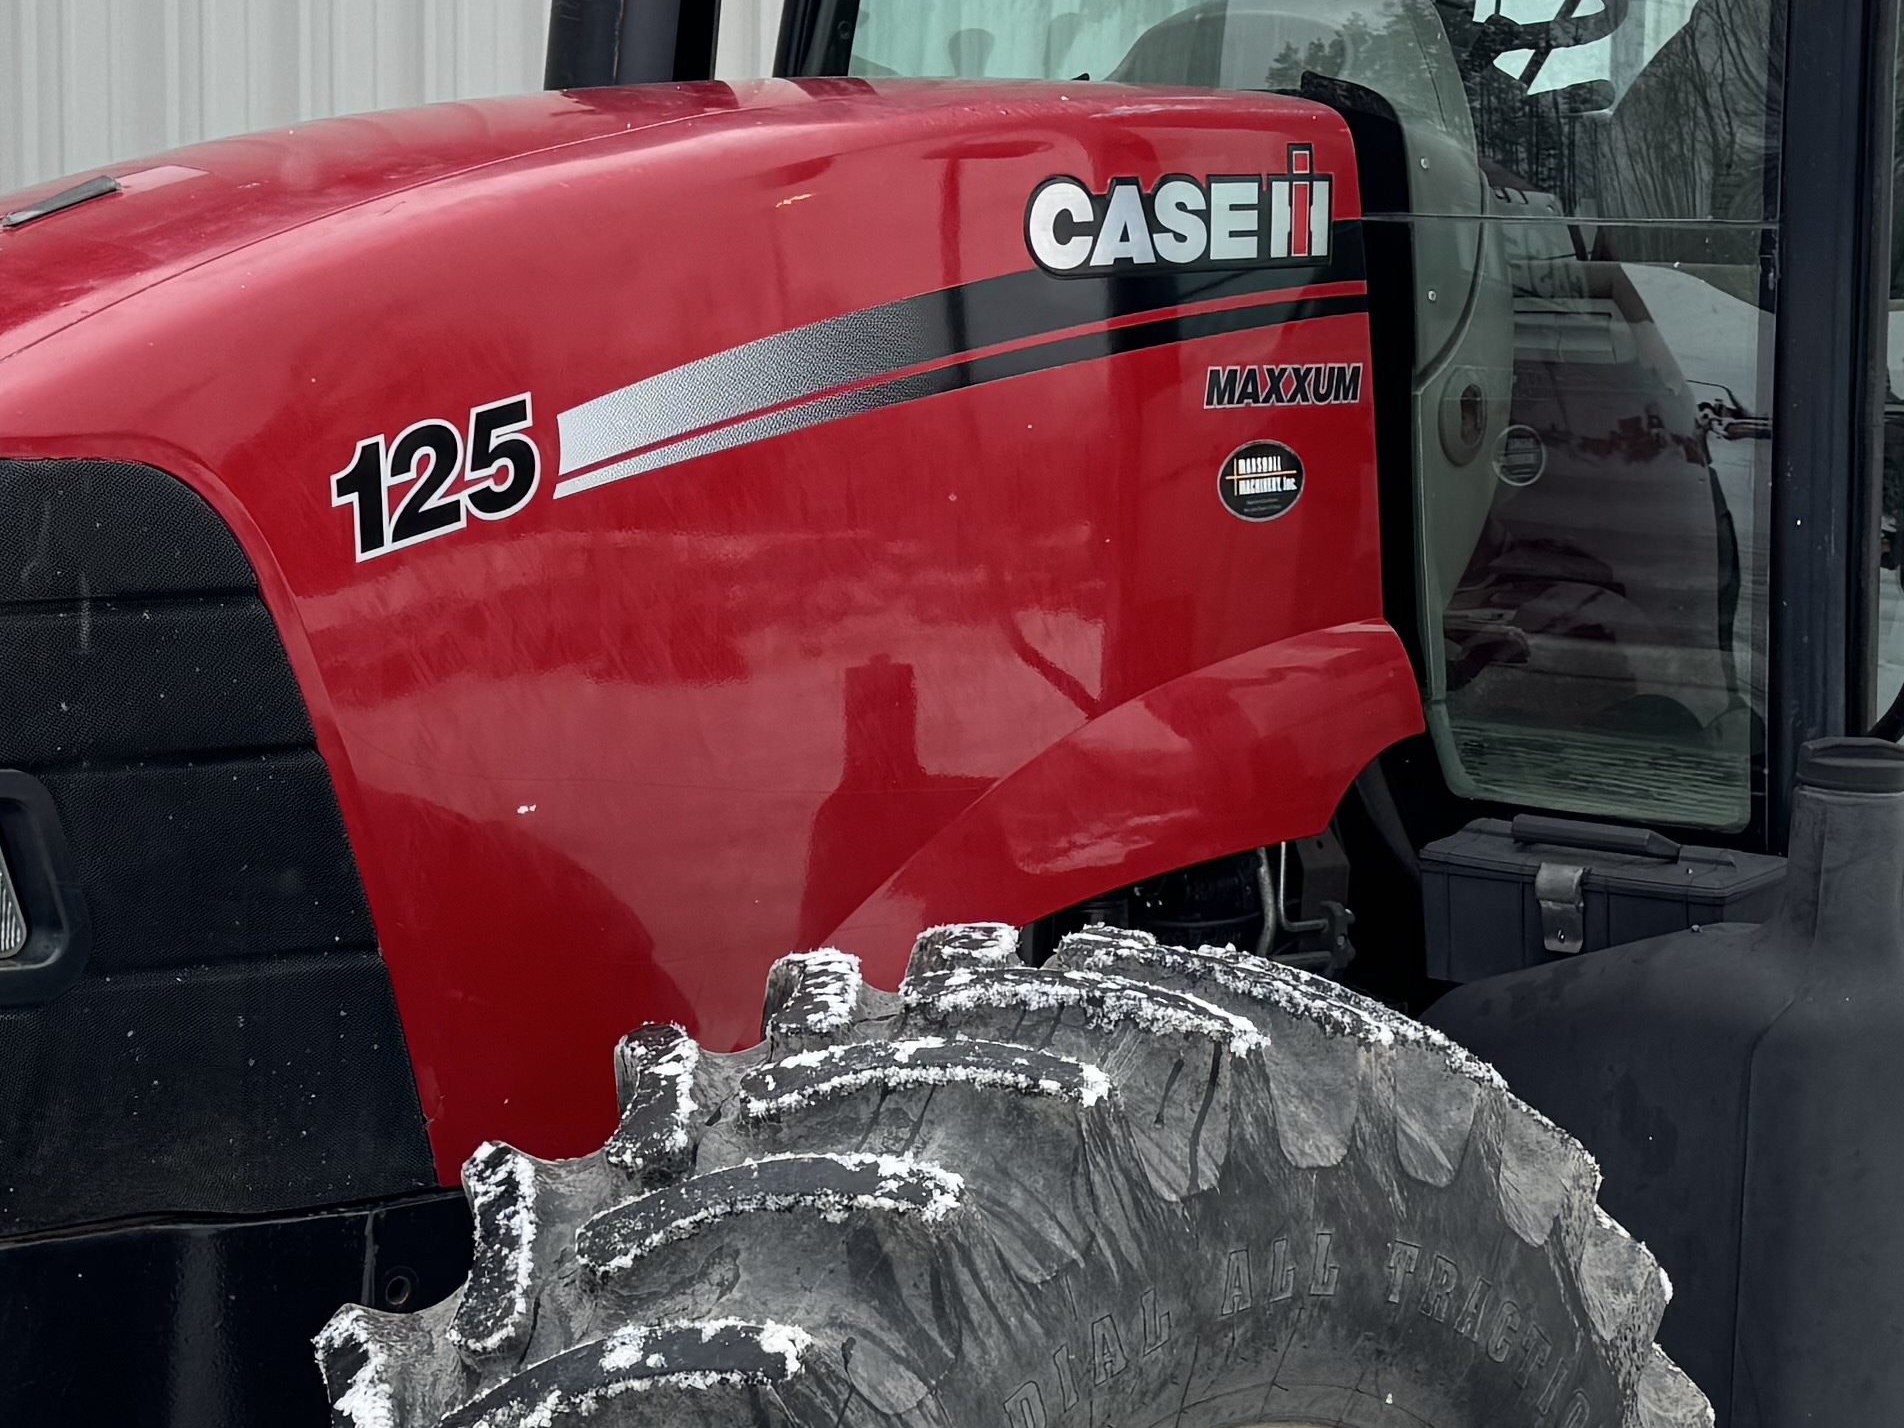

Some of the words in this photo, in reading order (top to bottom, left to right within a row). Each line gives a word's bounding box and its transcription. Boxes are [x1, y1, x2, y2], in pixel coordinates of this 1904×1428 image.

[1204, 363, 1362, 409] MAXXUM
[330, 392, 540, 563] 125
[1220, 1231, 1341, 1318] ALL
